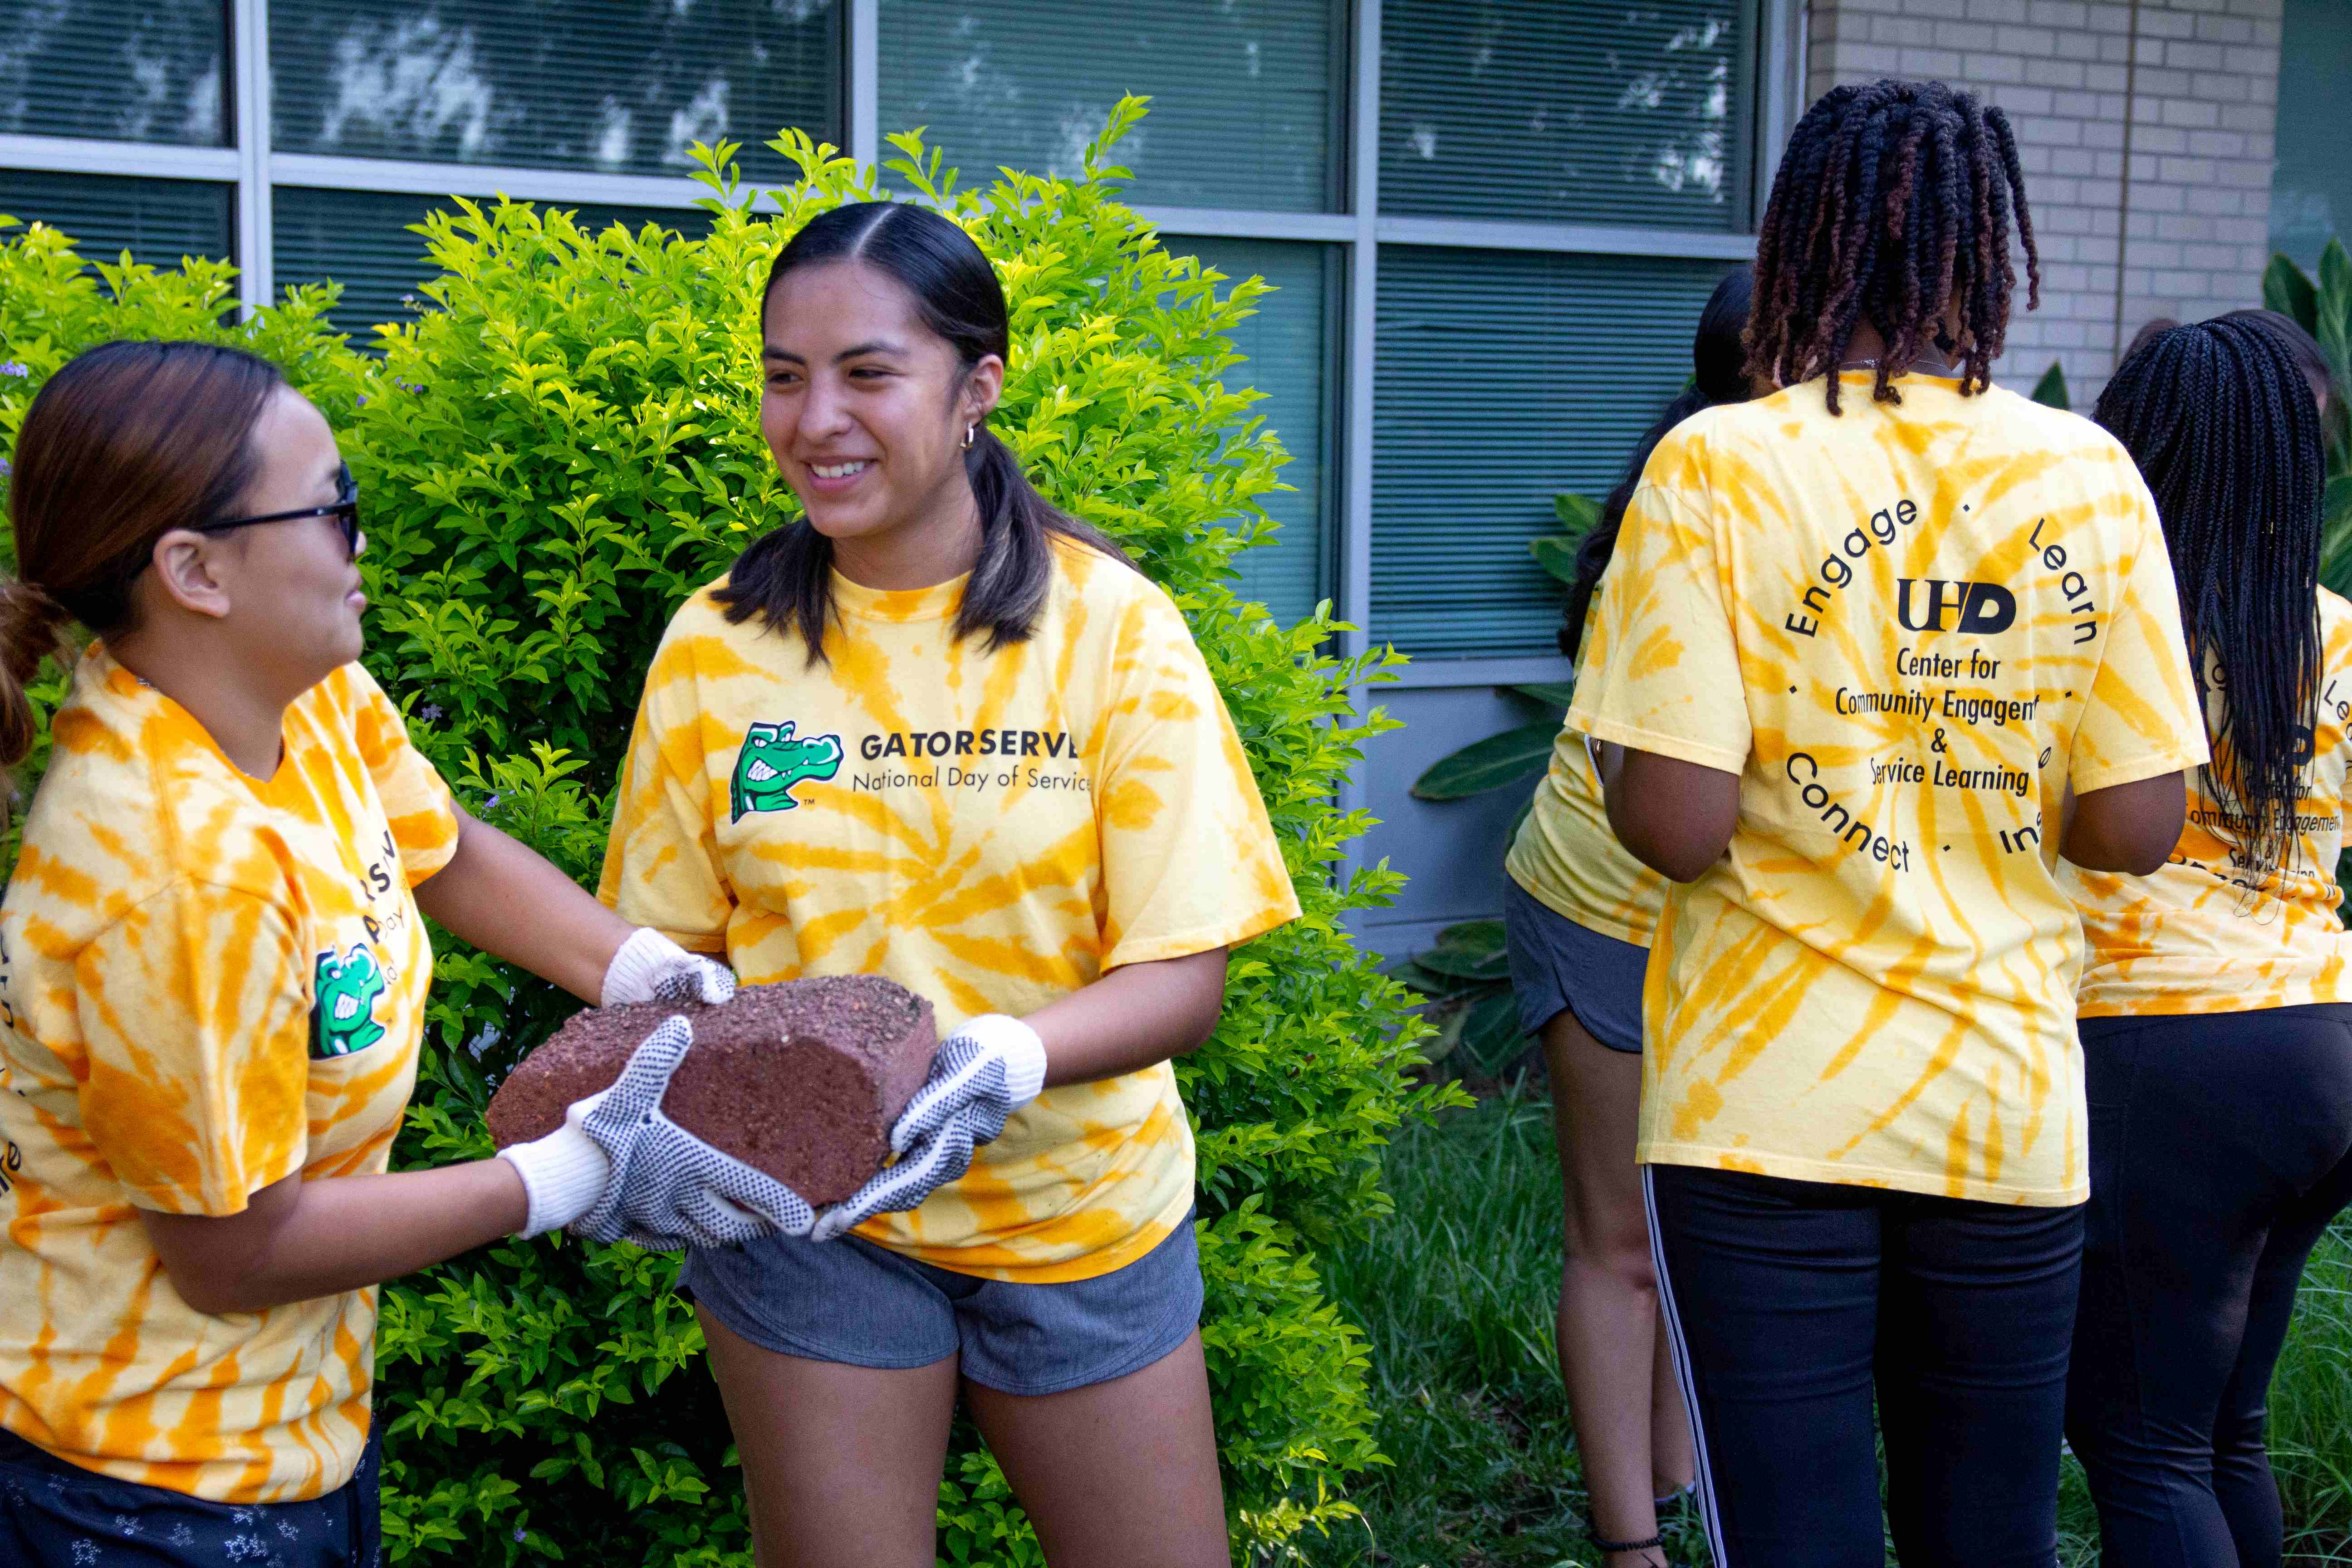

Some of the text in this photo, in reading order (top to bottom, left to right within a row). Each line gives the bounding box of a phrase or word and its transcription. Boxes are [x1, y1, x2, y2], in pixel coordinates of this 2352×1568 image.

[1784, 499, 1918, 637] Engage
[2029, 517, 2097, 645] Learn
[1896, 578, 2017, 635] UHD
[1896, 647, 2001, 680] Center for
[1835, 686, 1935, 723] Community
[1931, 727, 1948, 754] &
[853, 766, 939, 792] National
[948, 767, 989, 792] Day
[998, 764, 1019, 786] of
[1870, 757, 2029, 798] Service Learning
[1786, 752, 1909, 872] Connect
